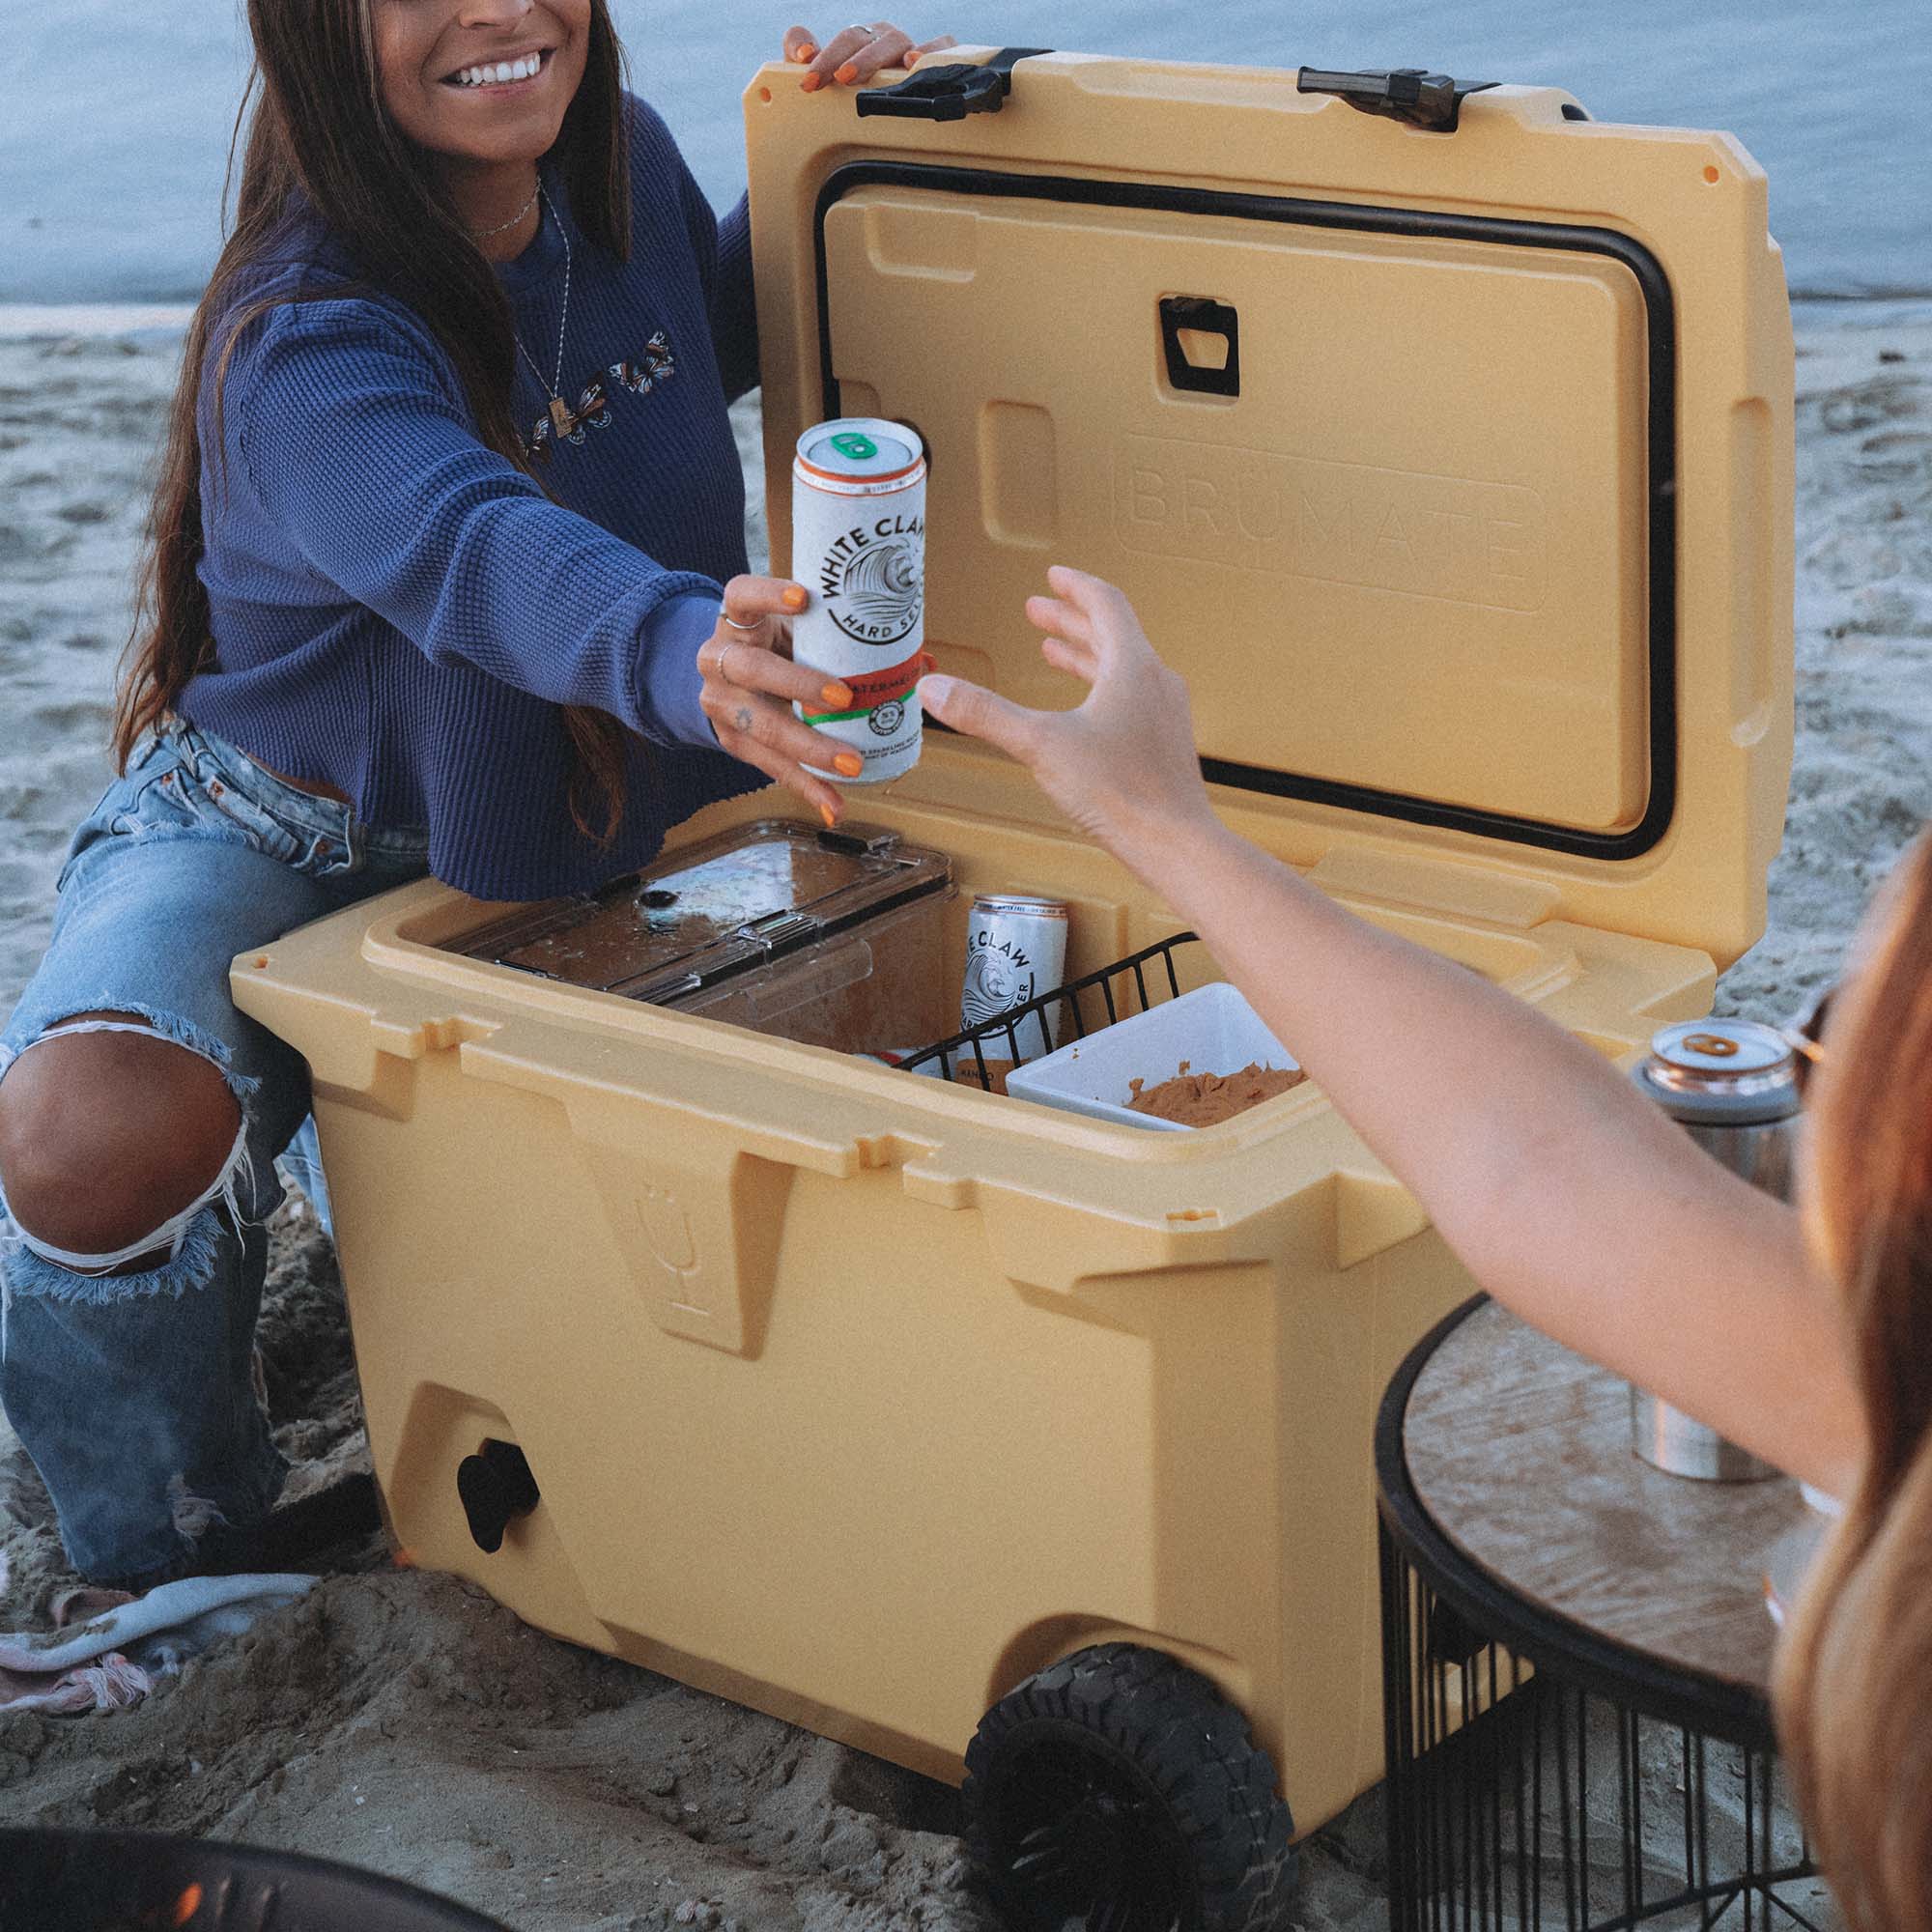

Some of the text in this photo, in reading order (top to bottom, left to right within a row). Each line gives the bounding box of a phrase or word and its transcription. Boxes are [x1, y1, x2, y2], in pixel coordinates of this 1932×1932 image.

[820, 527, 869, 599] WHITE
[842, 614, 893, 639] HARD
[978, 930, 1030, 969] CLAW
